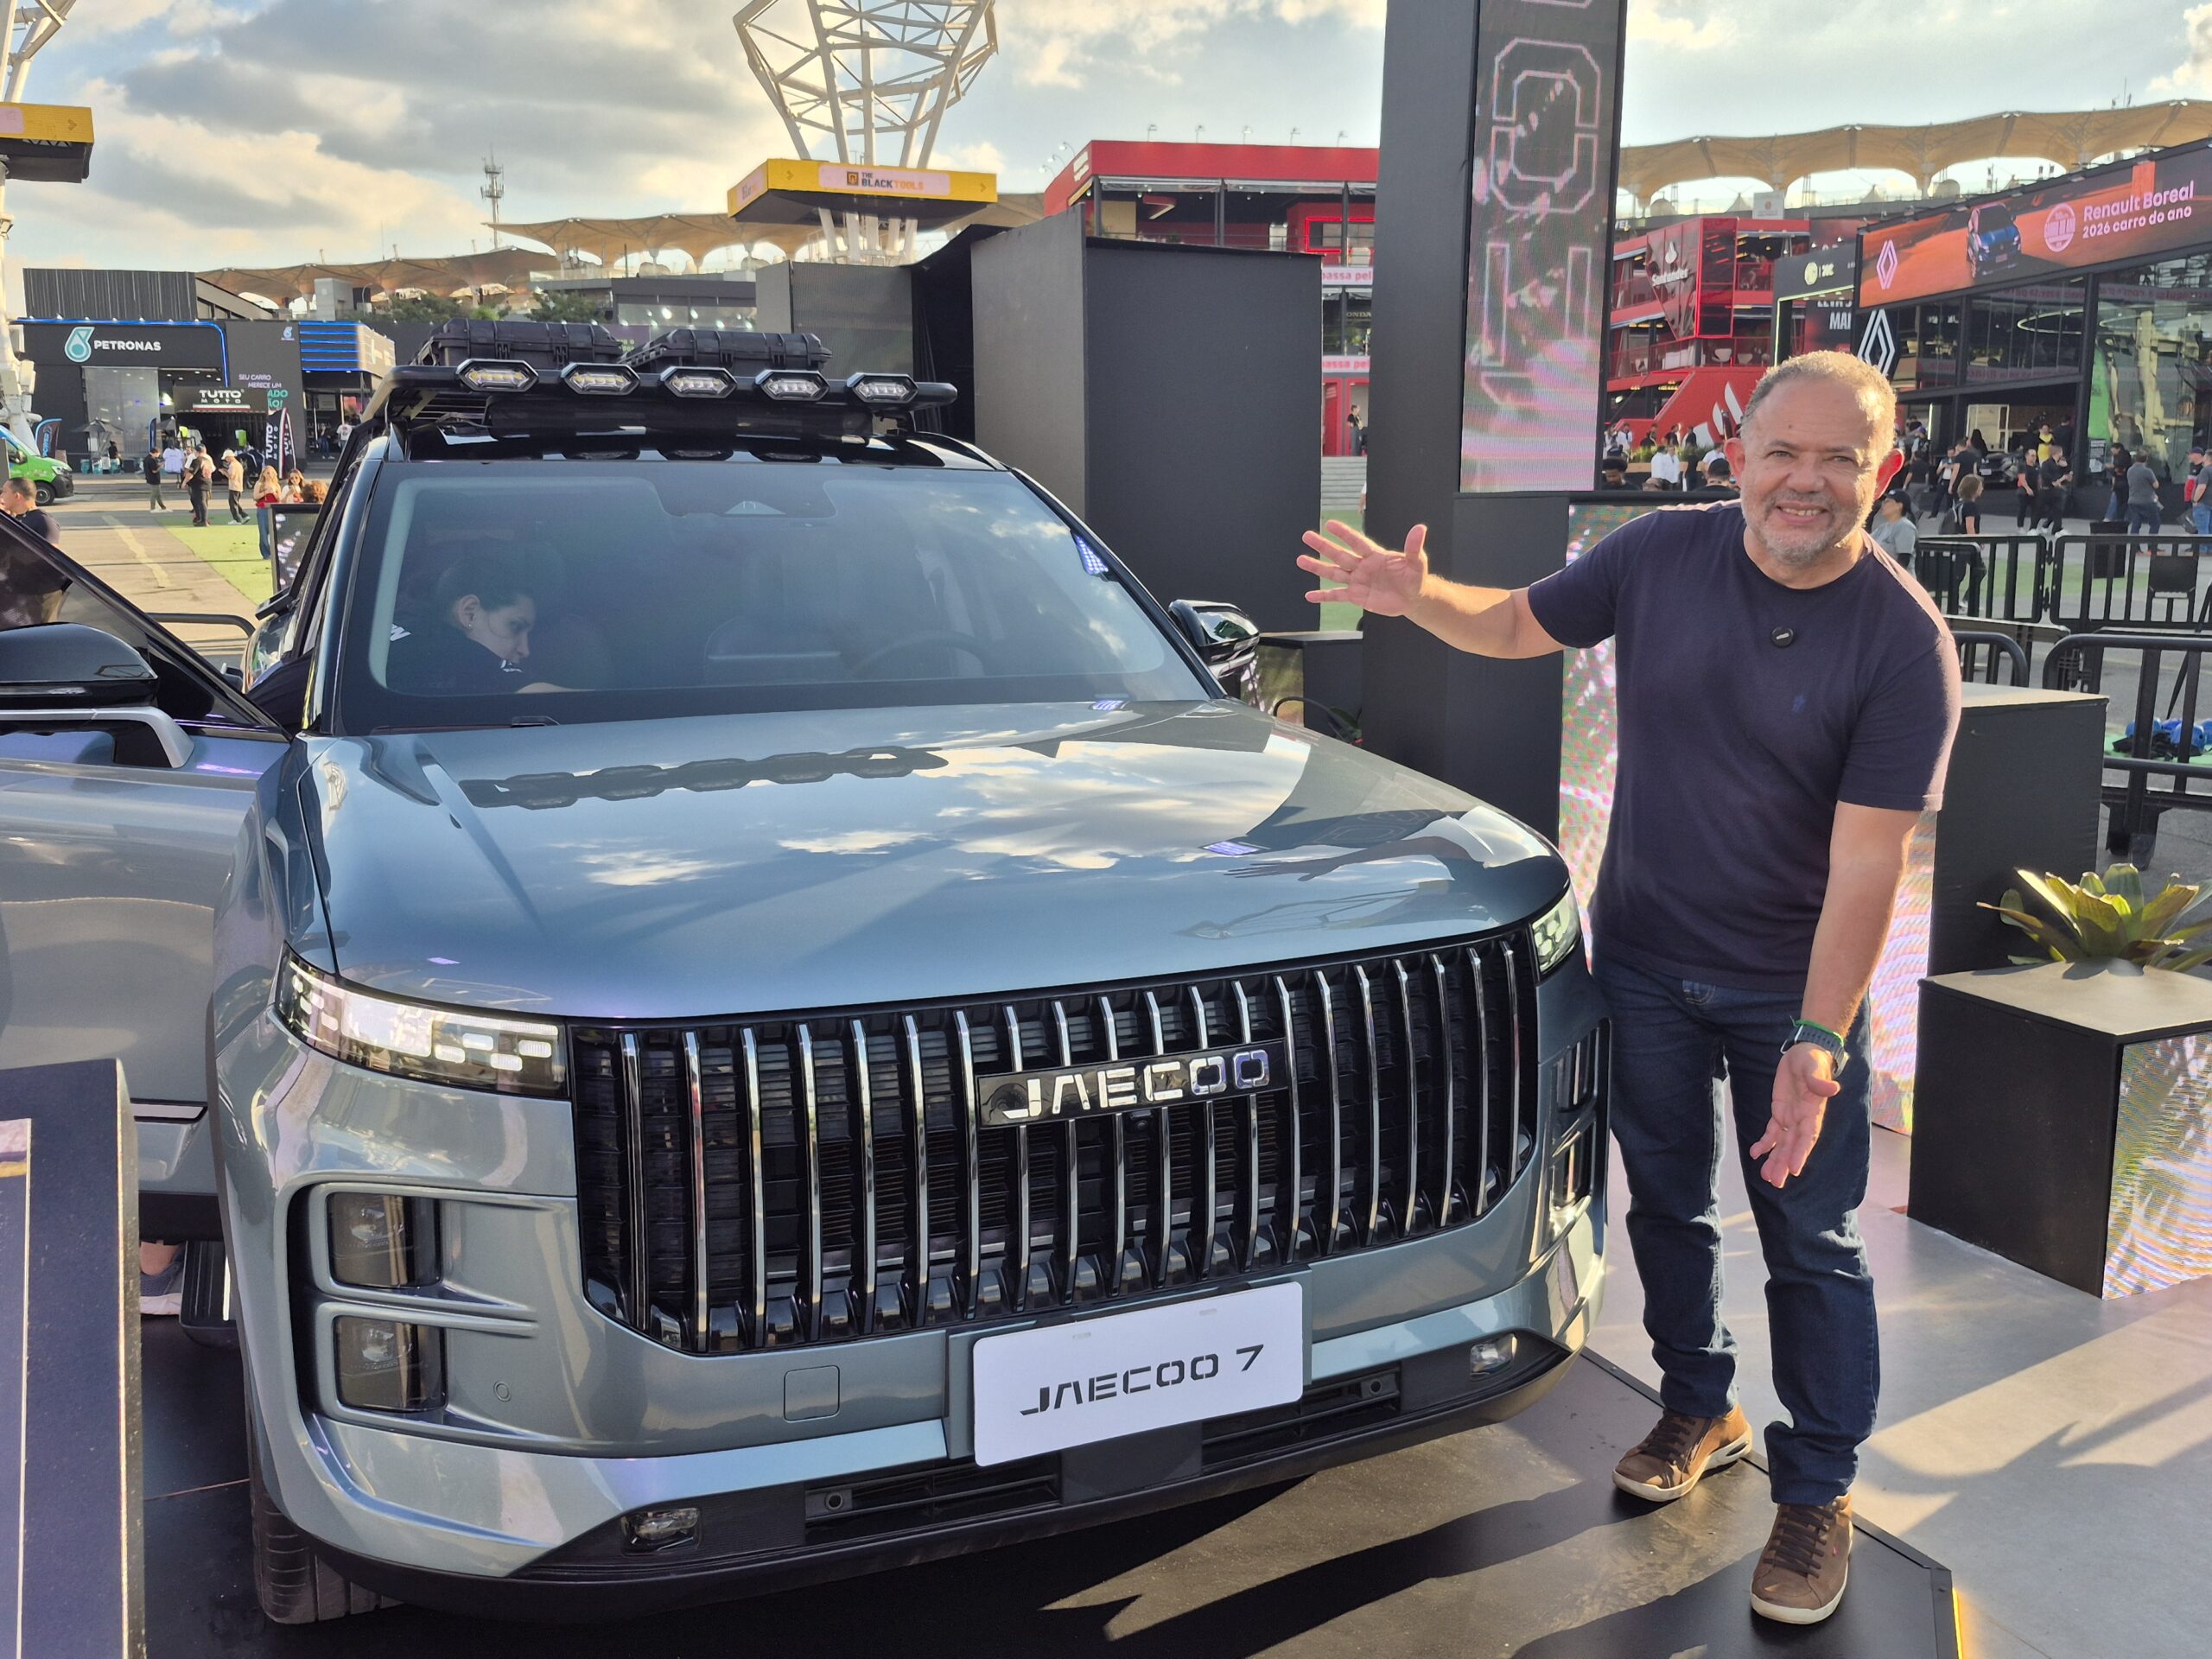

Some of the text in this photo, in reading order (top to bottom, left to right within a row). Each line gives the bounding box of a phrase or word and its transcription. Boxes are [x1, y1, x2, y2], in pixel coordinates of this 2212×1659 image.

[2083, 180, 2195, 222] Renault Boreal
[2082, 221, 2111, 238] 2026
[2113, 216, 2146, 232] carro
[2149, 210, 2164, 226] do
[2167, 206, 2192, 220] ano
[1322, 270, 1372, 282] assa pel
[1651, 267, 1688, 287] Santander
[93, 340, 162, 352] PETRONAS
[199, 390, 243, 398] TUTTO
[267, 389, 289, 397] ADO
[265, 424, 274, 460] TUTTO
[1002, 1049, 1270, 1120] JAECOO
[1020, 1344, 1265, 1416] JAECOO 7
